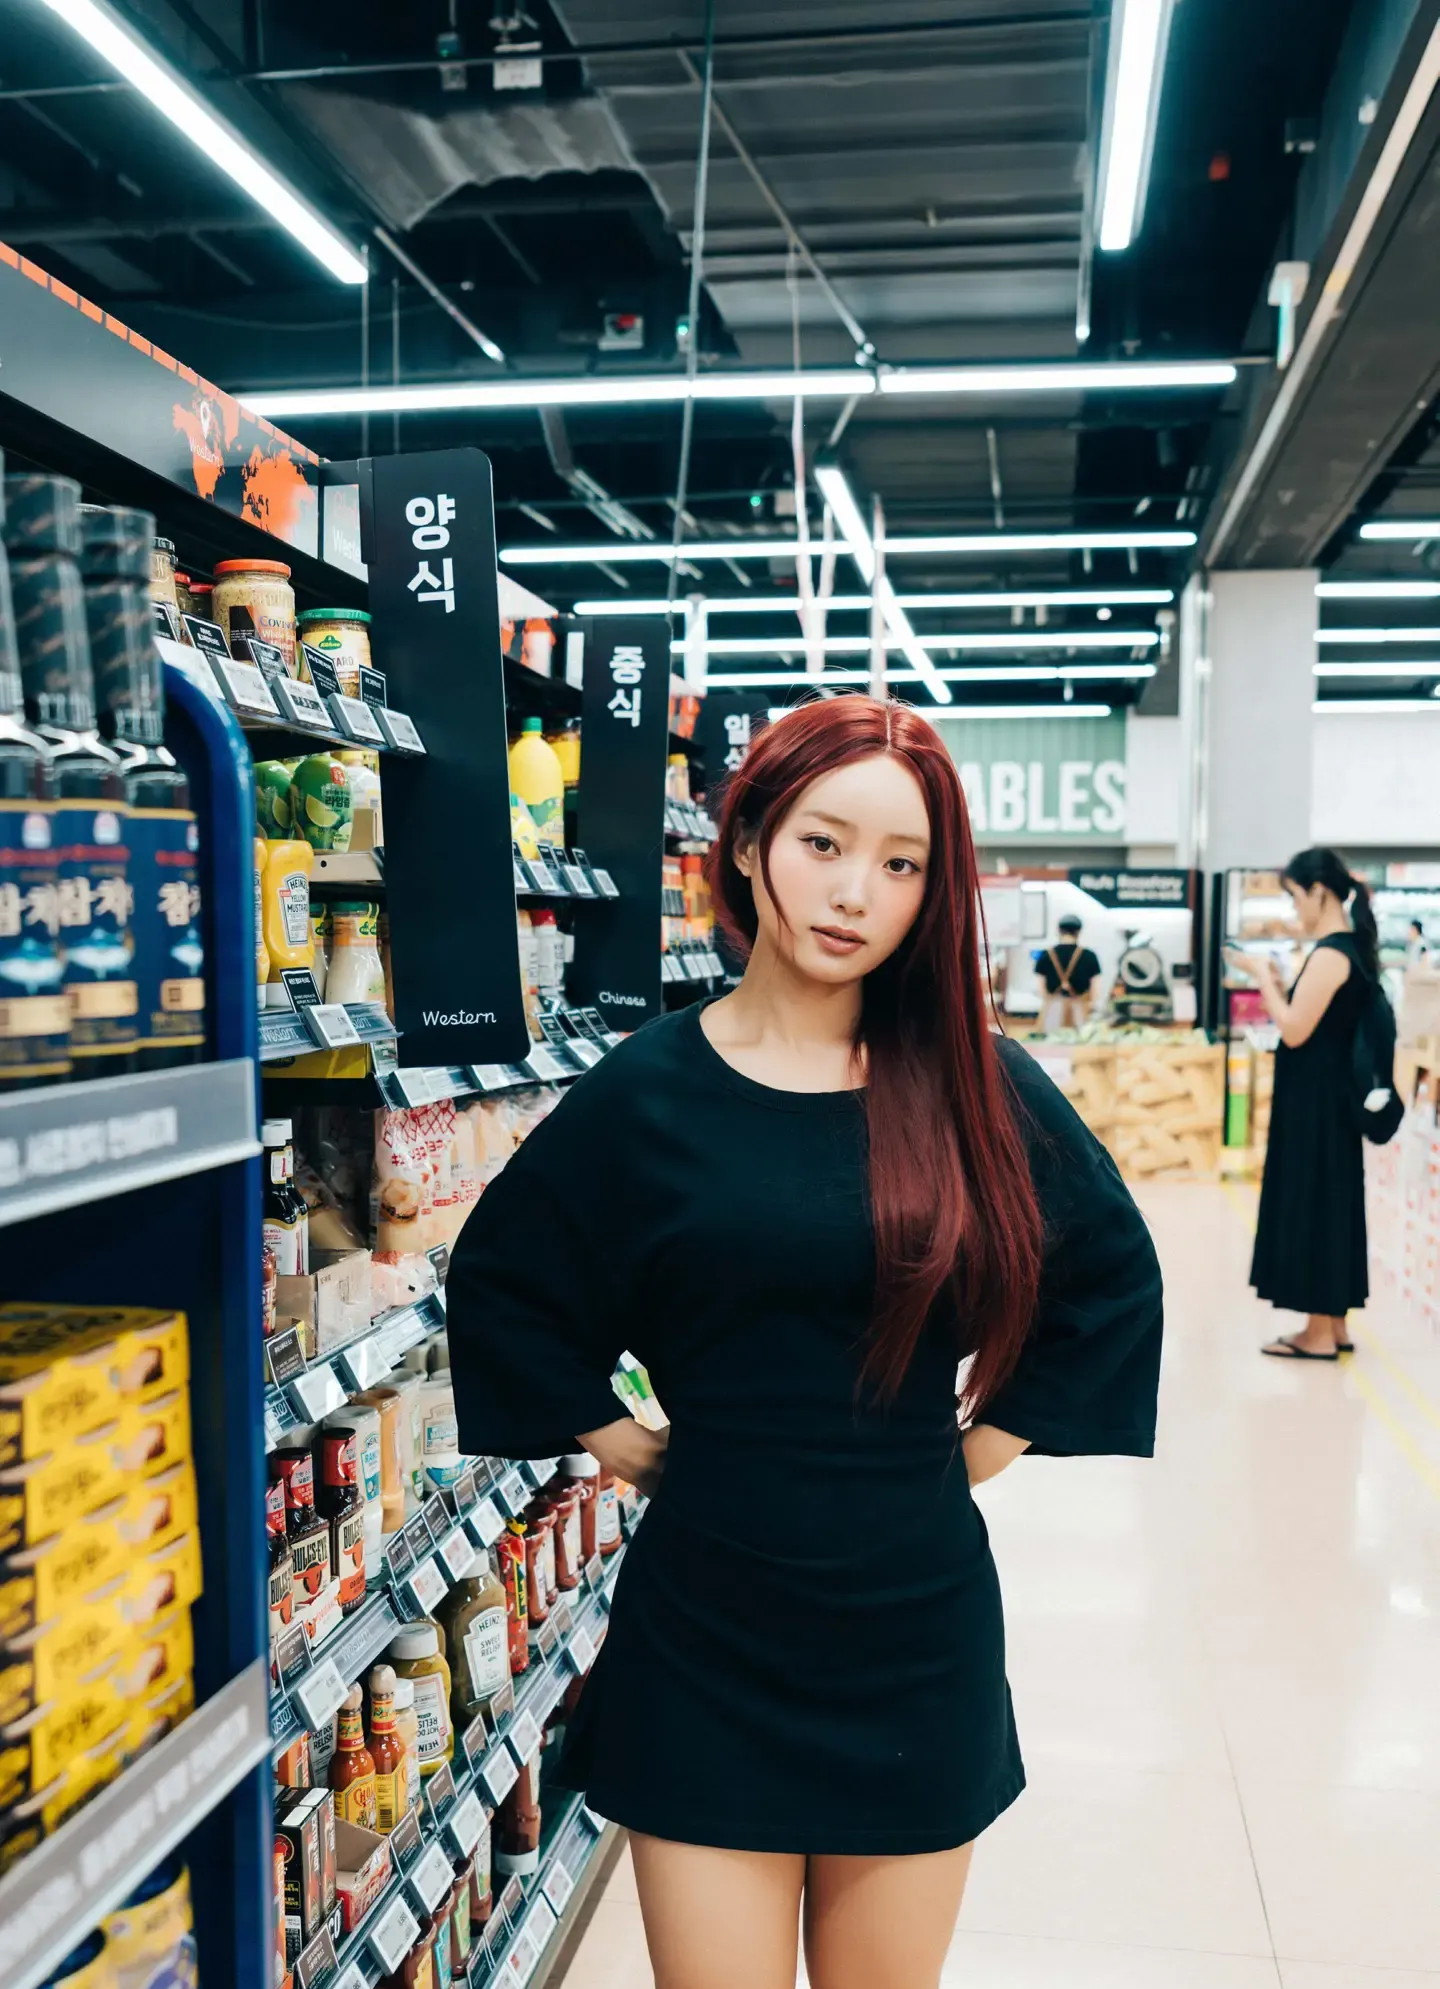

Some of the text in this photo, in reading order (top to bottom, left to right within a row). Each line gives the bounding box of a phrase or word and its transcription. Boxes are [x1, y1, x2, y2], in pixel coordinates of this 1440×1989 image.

[405, 493, 456, 614] 양식
[607, 645, 646, 728] 중식
[958, 760, 1126, 833] ABLES
[599, 991, 647, 1007] Chinese
[424, 1009, 497, 1026] Western
[417, 1715, 438, 1729] RELIS
[312, 1729, 324, 1740] HOT
[313, 1733, 333, 1750] RELISH
[418, 1739, 440, 1753] HEIN
